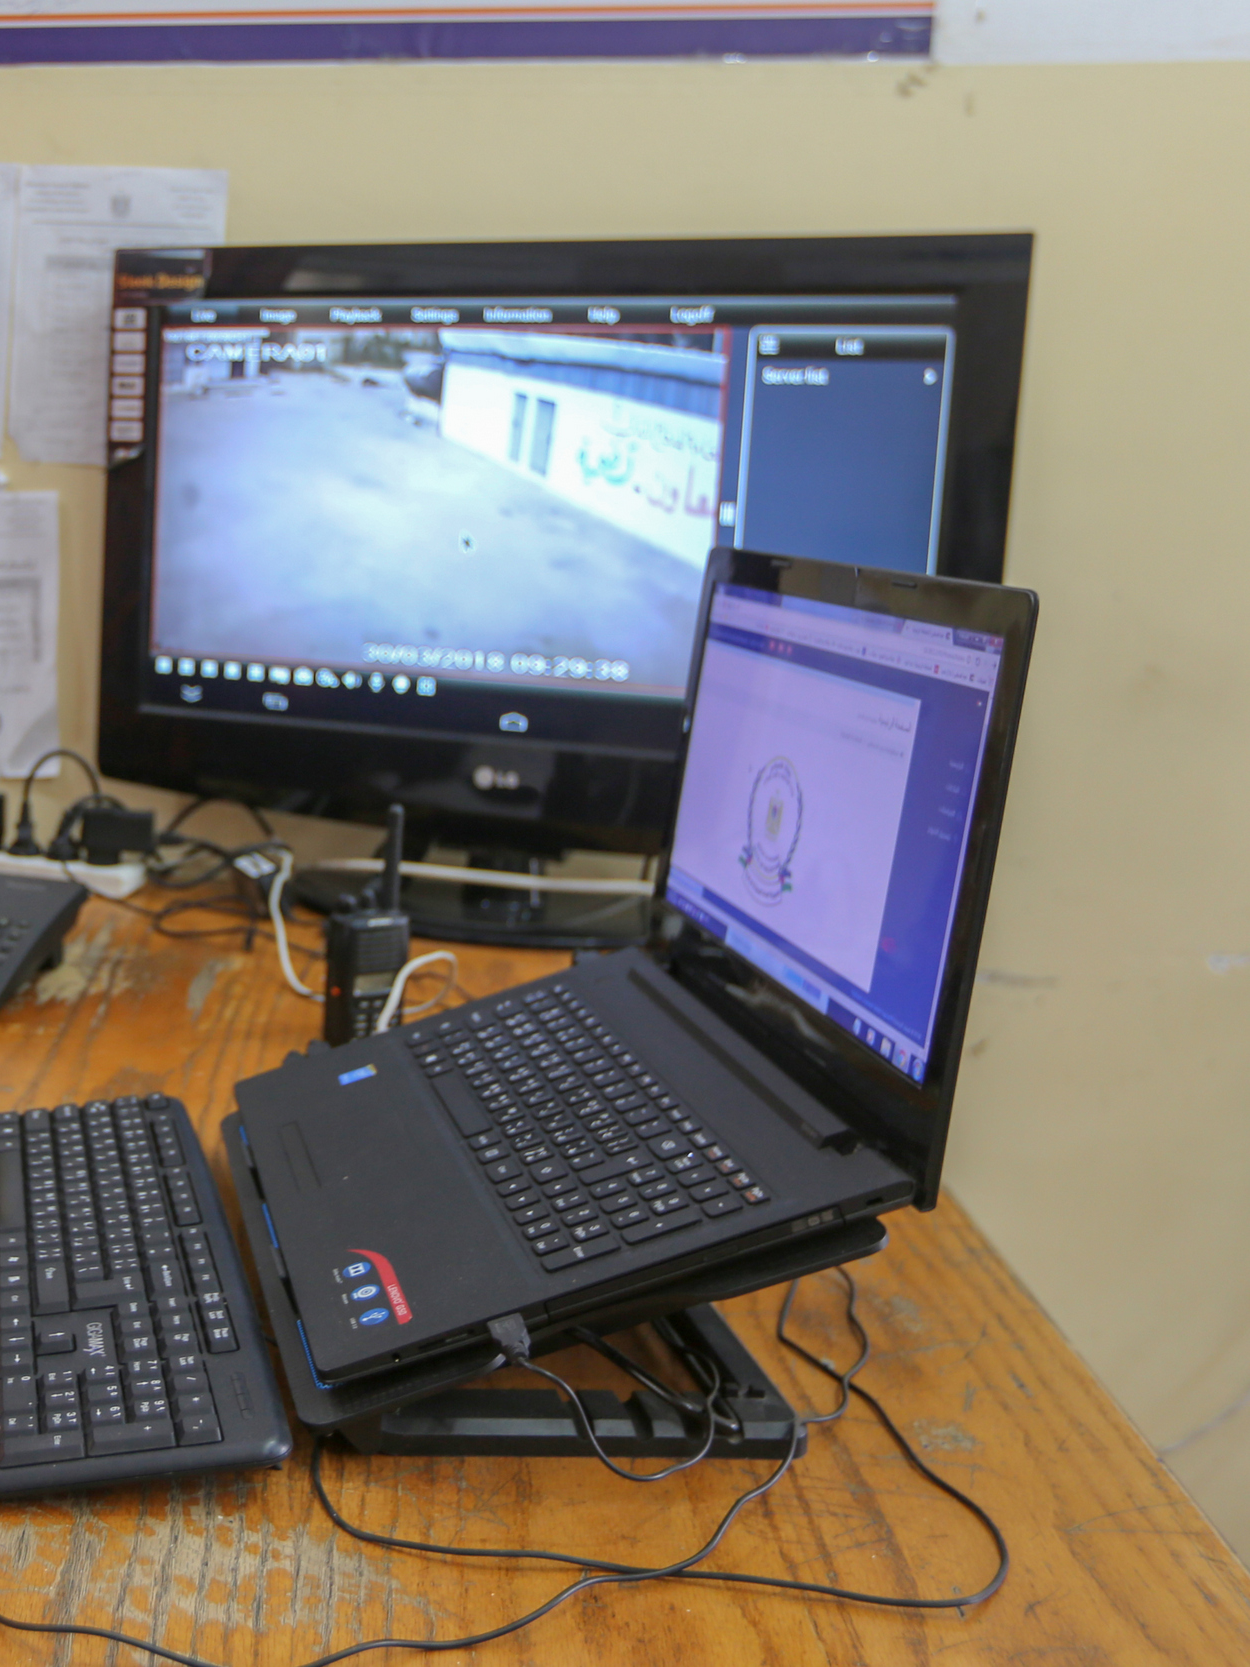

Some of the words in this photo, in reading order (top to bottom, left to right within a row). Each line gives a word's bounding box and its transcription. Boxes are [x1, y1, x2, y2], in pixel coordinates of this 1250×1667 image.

[259, 308, 298, 325] Image
[483, 306, 553, 324] Information
[387, 1283, 405, 1304] LENOVO
[83, 1321, 105, 1356] GIGAMAX
